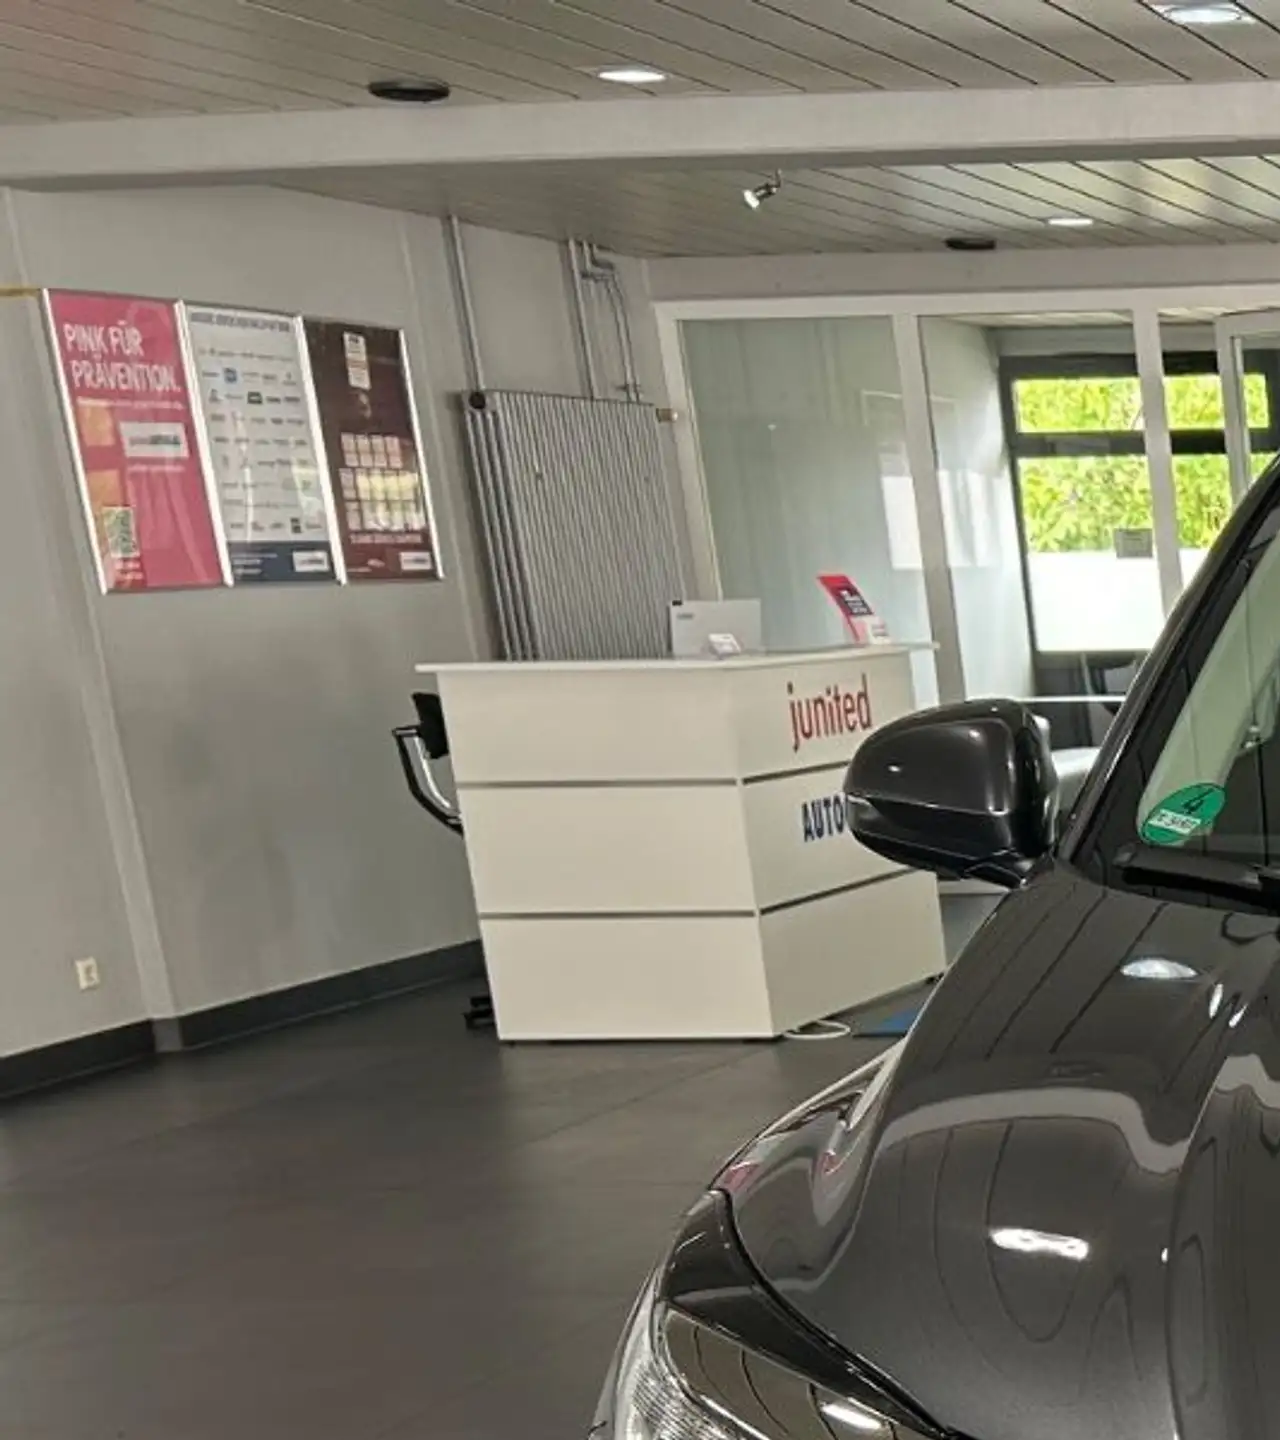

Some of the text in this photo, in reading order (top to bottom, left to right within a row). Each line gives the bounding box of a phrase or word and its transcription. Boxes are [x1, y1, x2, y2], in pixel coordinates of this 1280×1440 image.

[63, 319, 144, 356] PINK FÜR
[71, 353, 181, 392] PRÄVENTION.
[787, 673, 873, 752] junited
